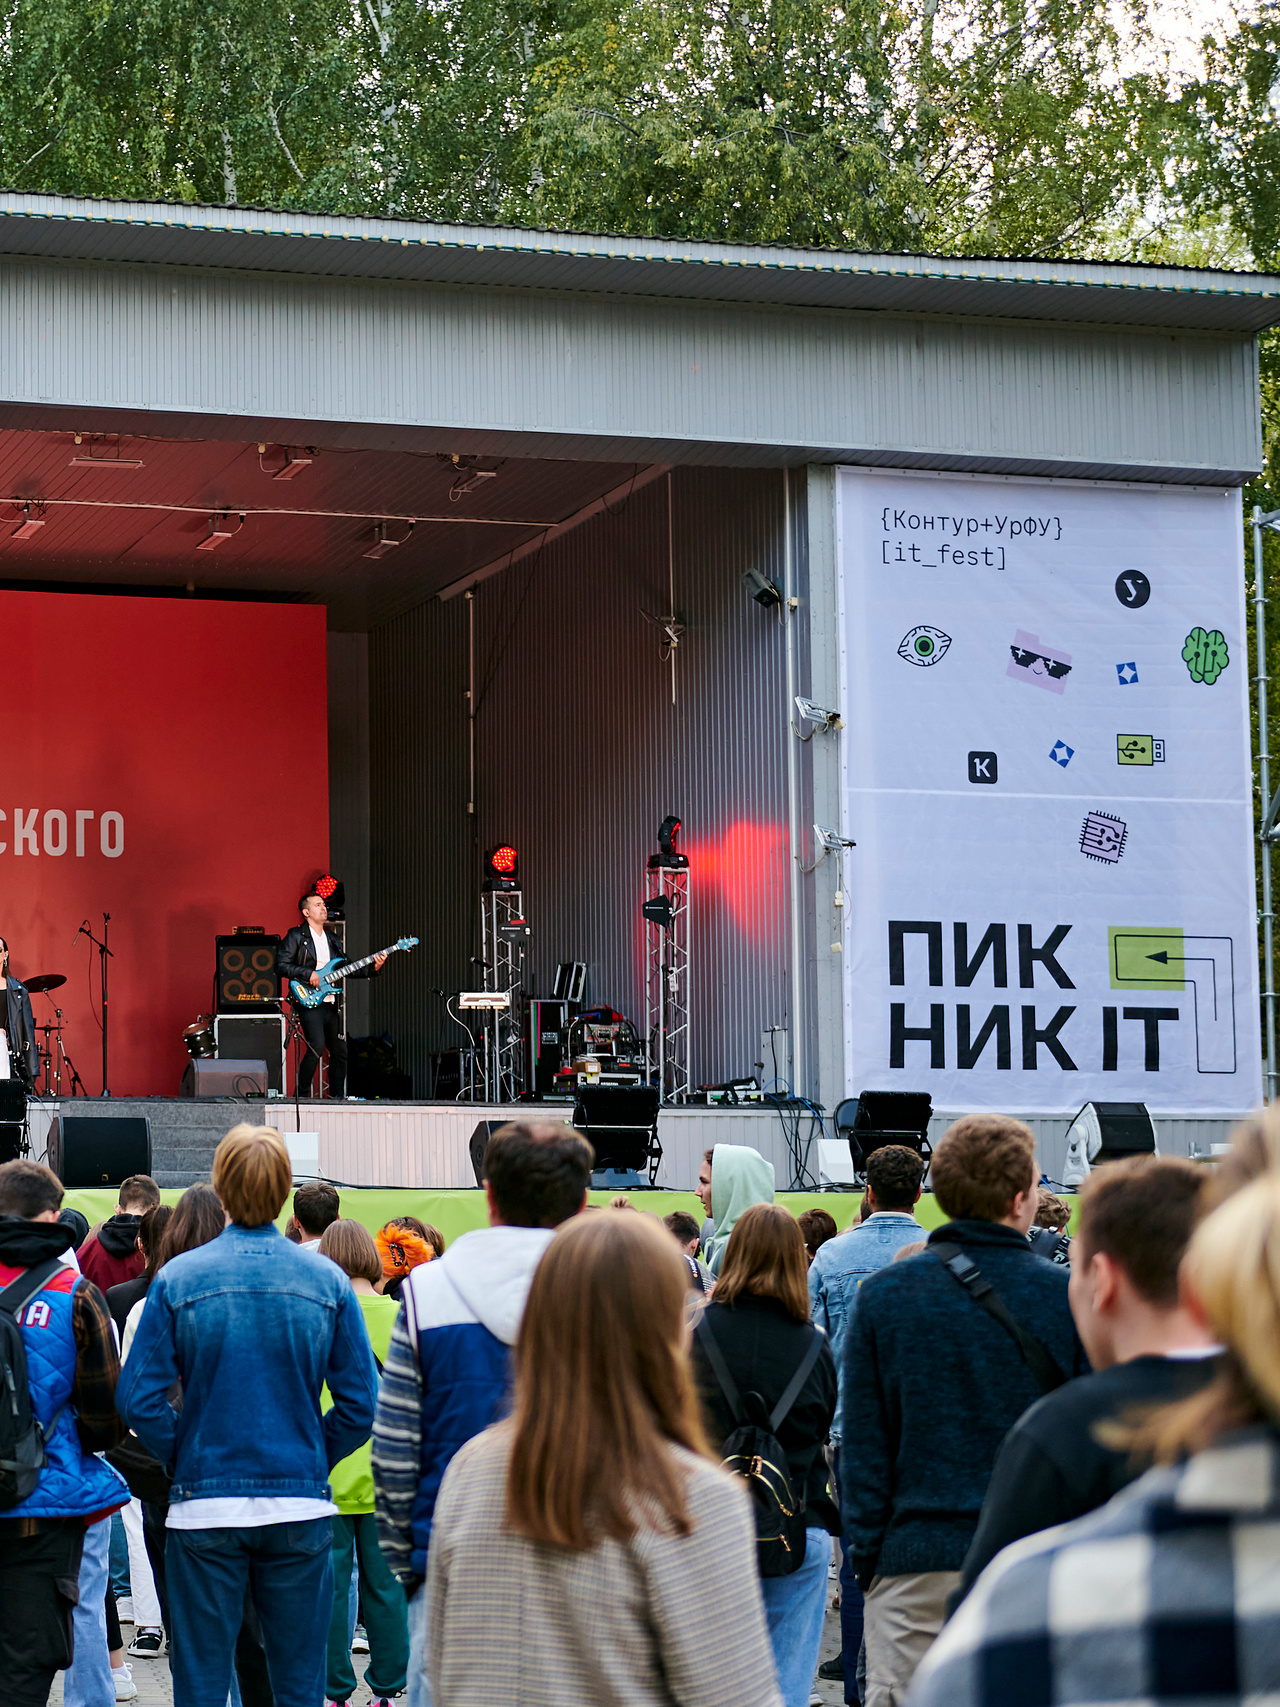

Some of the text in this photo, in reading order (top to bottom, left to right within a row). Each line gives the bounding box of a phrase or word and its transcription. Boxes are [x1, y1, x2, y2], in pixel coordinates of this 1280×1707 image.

[882, 540, 1005, 571] [it_fest]
[887, 919, 1077, 990] ПИК
[889, 1003, 1179, 1072] НИК IT
